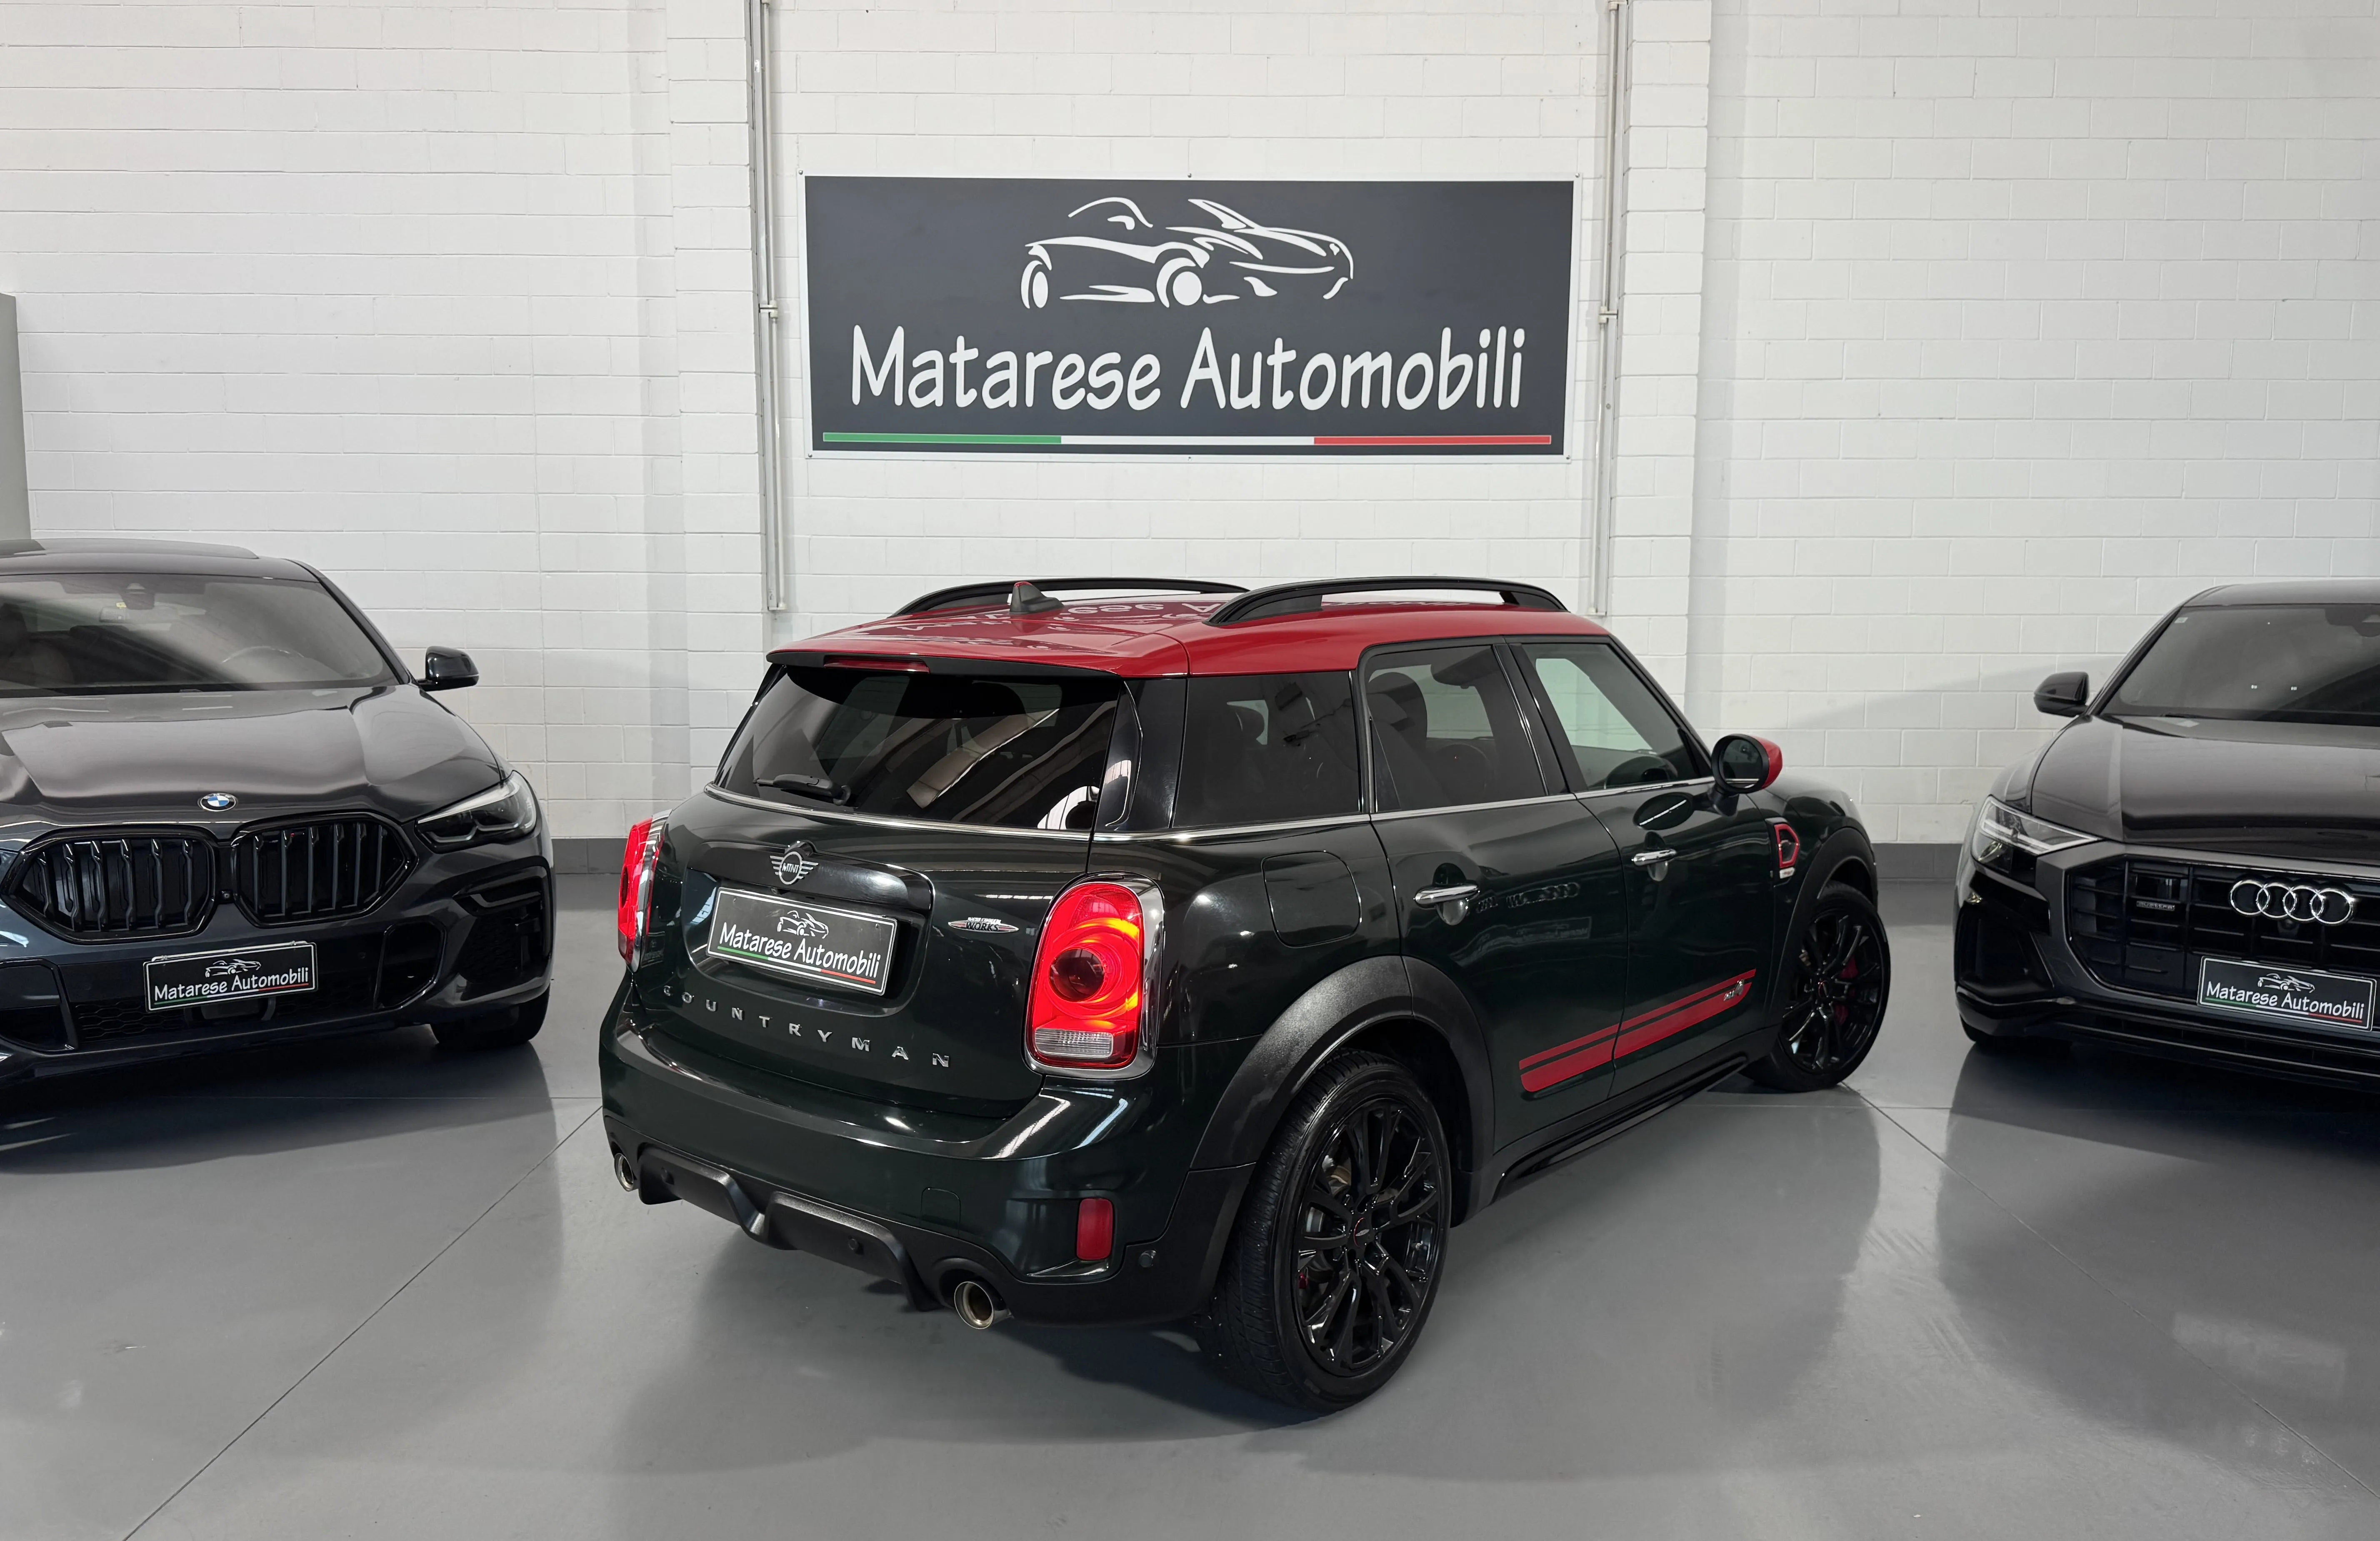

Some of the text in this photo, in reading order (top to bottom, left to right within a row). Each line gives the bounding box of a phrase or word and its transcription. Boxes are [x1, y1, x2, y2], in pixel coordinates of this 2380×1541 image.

[852, 325, 1525, 410] Matarese Automobili
[782, 862, 799, 874] MINI
[966, 922, 999, 932] WORKS
[719, 922, 881, 978] Matarese Automobili
[154, 967, 309, 1001] Matarese Automobili
[2206, 981, 2364, 1019] Matarese Automobili
[663, 985, 950, 1068] COUNTRYMAN
